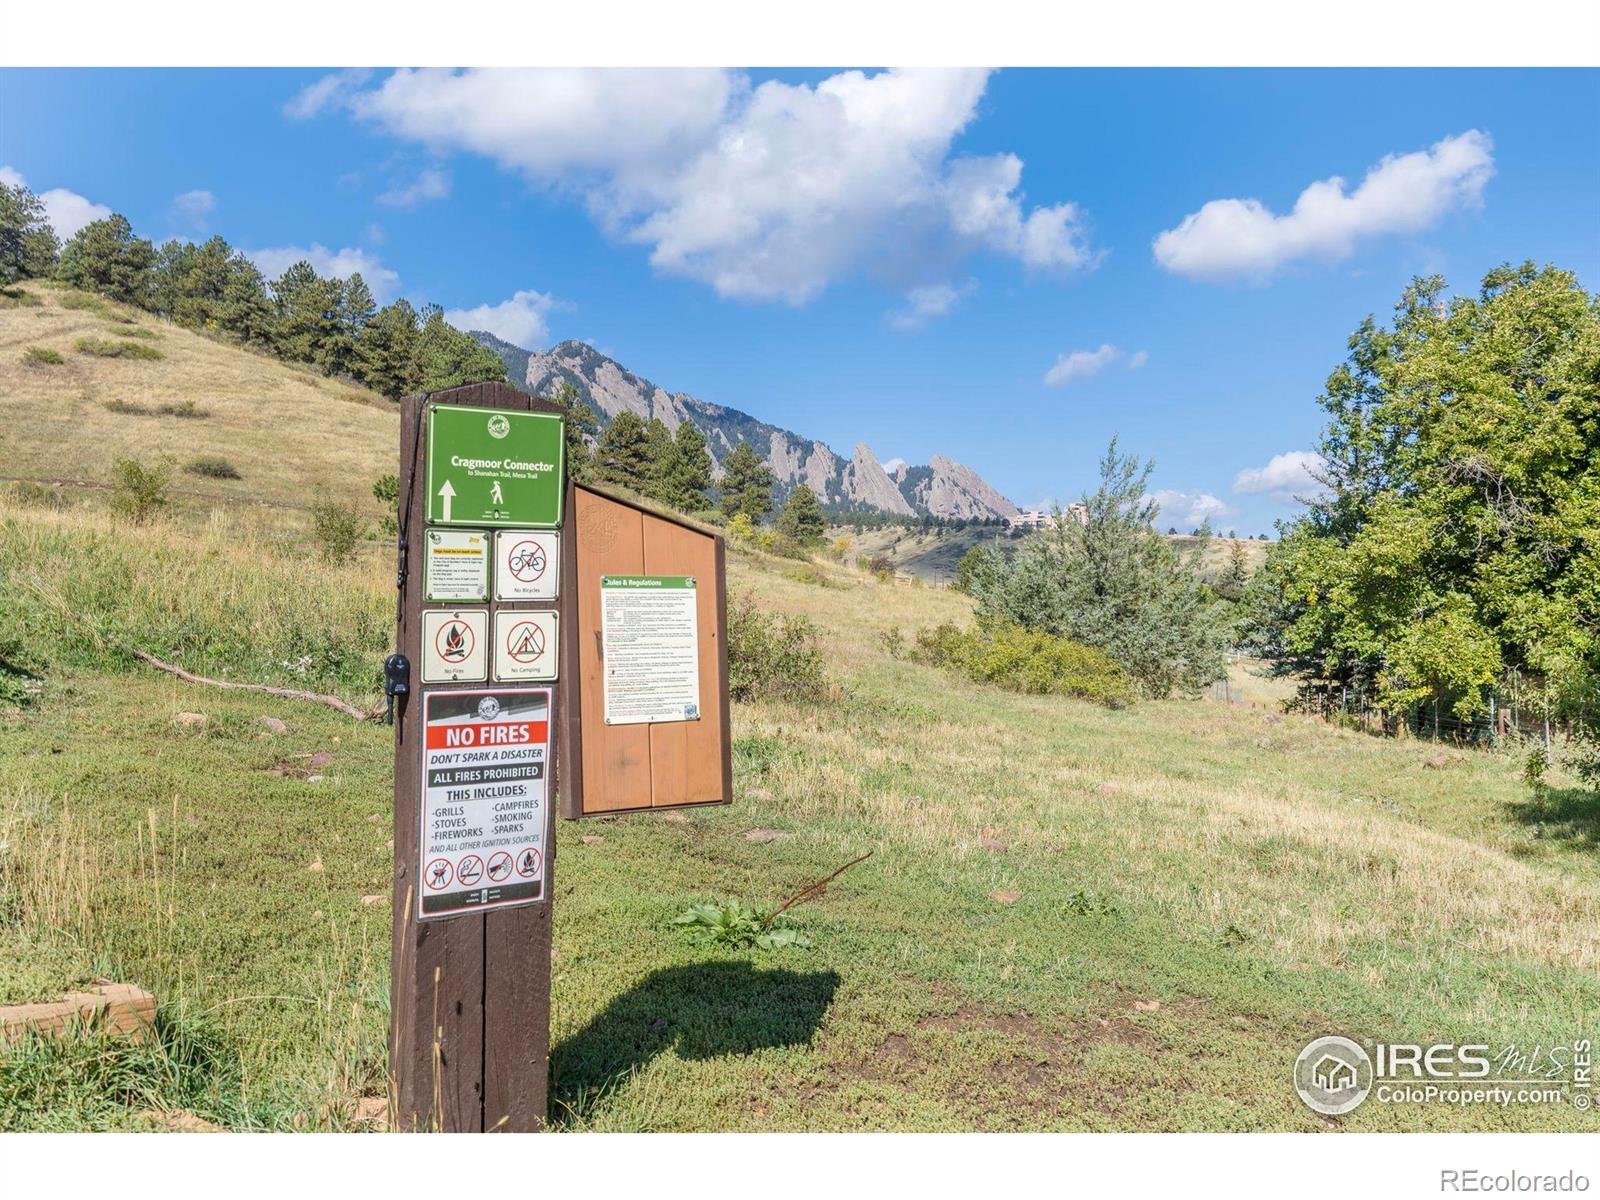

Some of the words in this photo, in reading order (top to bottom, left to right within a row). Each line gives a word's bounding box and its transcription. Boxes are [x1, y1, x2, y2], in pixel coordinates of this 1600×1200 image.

[451, 455, 502, 470] Cragmoor
[504, 458, 554, 472] Connector
[446, 728, 474, 746] NO
[480, 725, 529, 744] FIRES
[430, 752, 460, 764] DON'T
[462, 750, 491, 763] SPARK
[492, 750, 498, 760] A
[500, 748, 542, 760] DISASTER
[434, 772, 452, 783] ALL
[455, 770, 481, 781] FIRES
[483, 766, 538, 780] PROHIBITED
[446, 790, 471, 801] THIS
[474, 785, 527, 799] INCLUDES:
[432, 806, 464, 817] -GRILLS
[492, 800, 539, 812] -CAMPFIRES
[432, 818, 466, 829] -STOVES
[491, 812, 532, 823] -SMOKING
[431, 828, 483, 840] -FIREWORKS
[491, 824, 524, 835] -SPARKS
[429, 845, 445, 853] AND
[446, 844, 457, 852] ALL
[459, 842, 481, 850] OTHER
[482, 838, 510, 848] IGNITION
[512, 834, 540, 844] SOURCES
